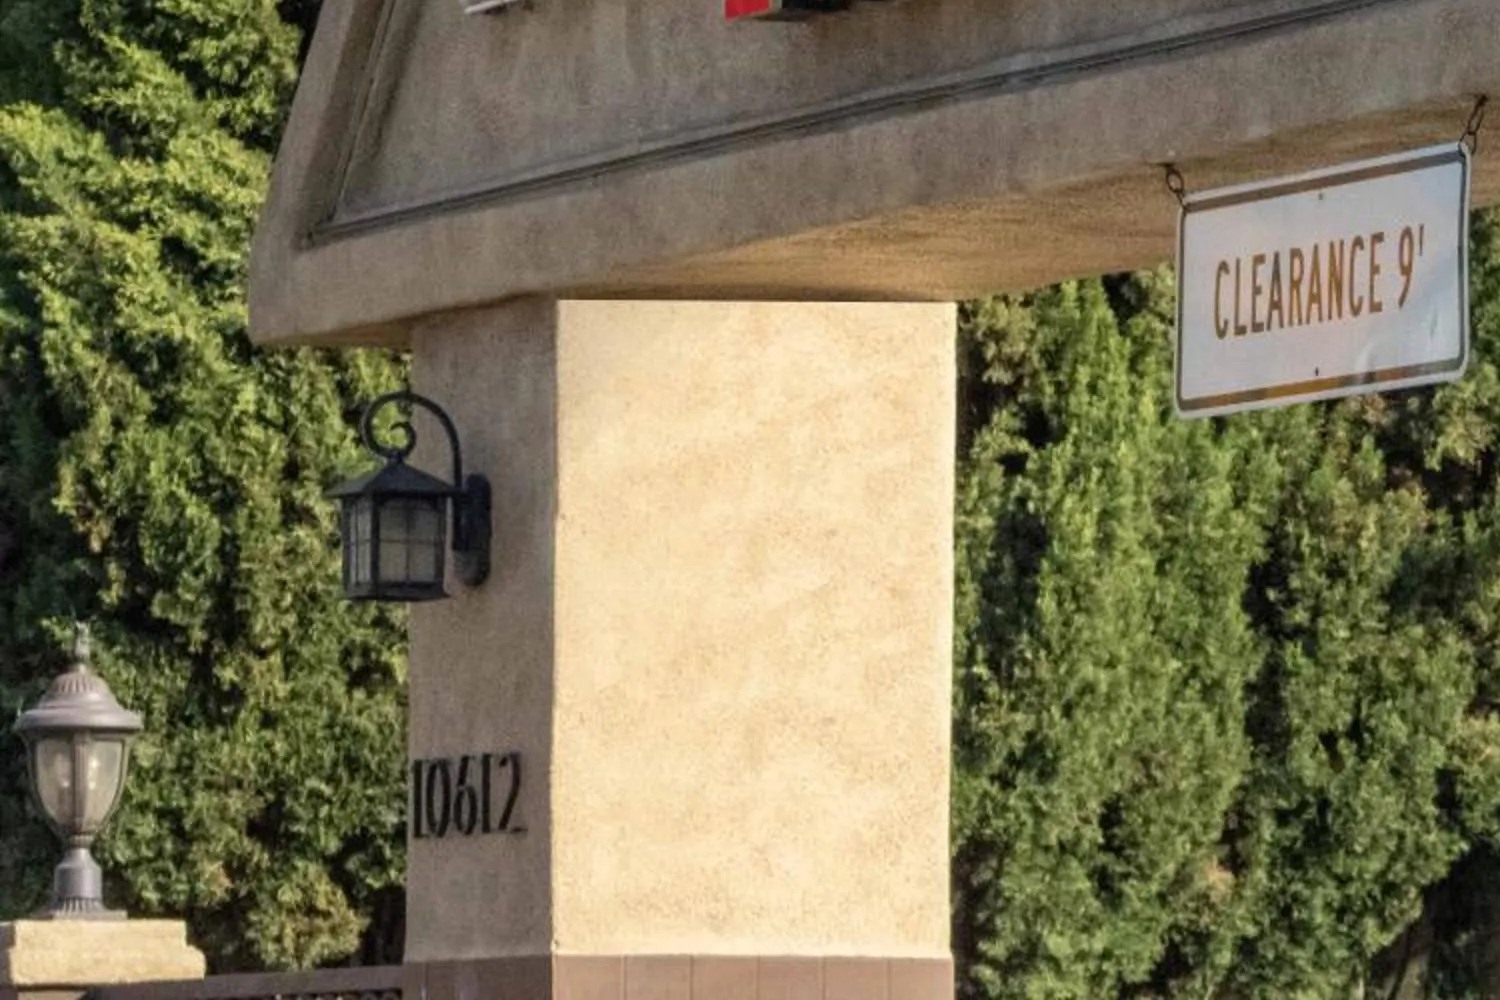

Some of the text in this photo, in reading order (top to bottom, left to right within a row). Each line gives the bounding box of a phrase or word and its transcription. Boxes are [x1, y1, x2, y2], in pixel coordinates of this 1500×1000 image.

[1212, 223, 1426, 341] CLEARANCE 9'
[410, 751, 529, 839] 10612
